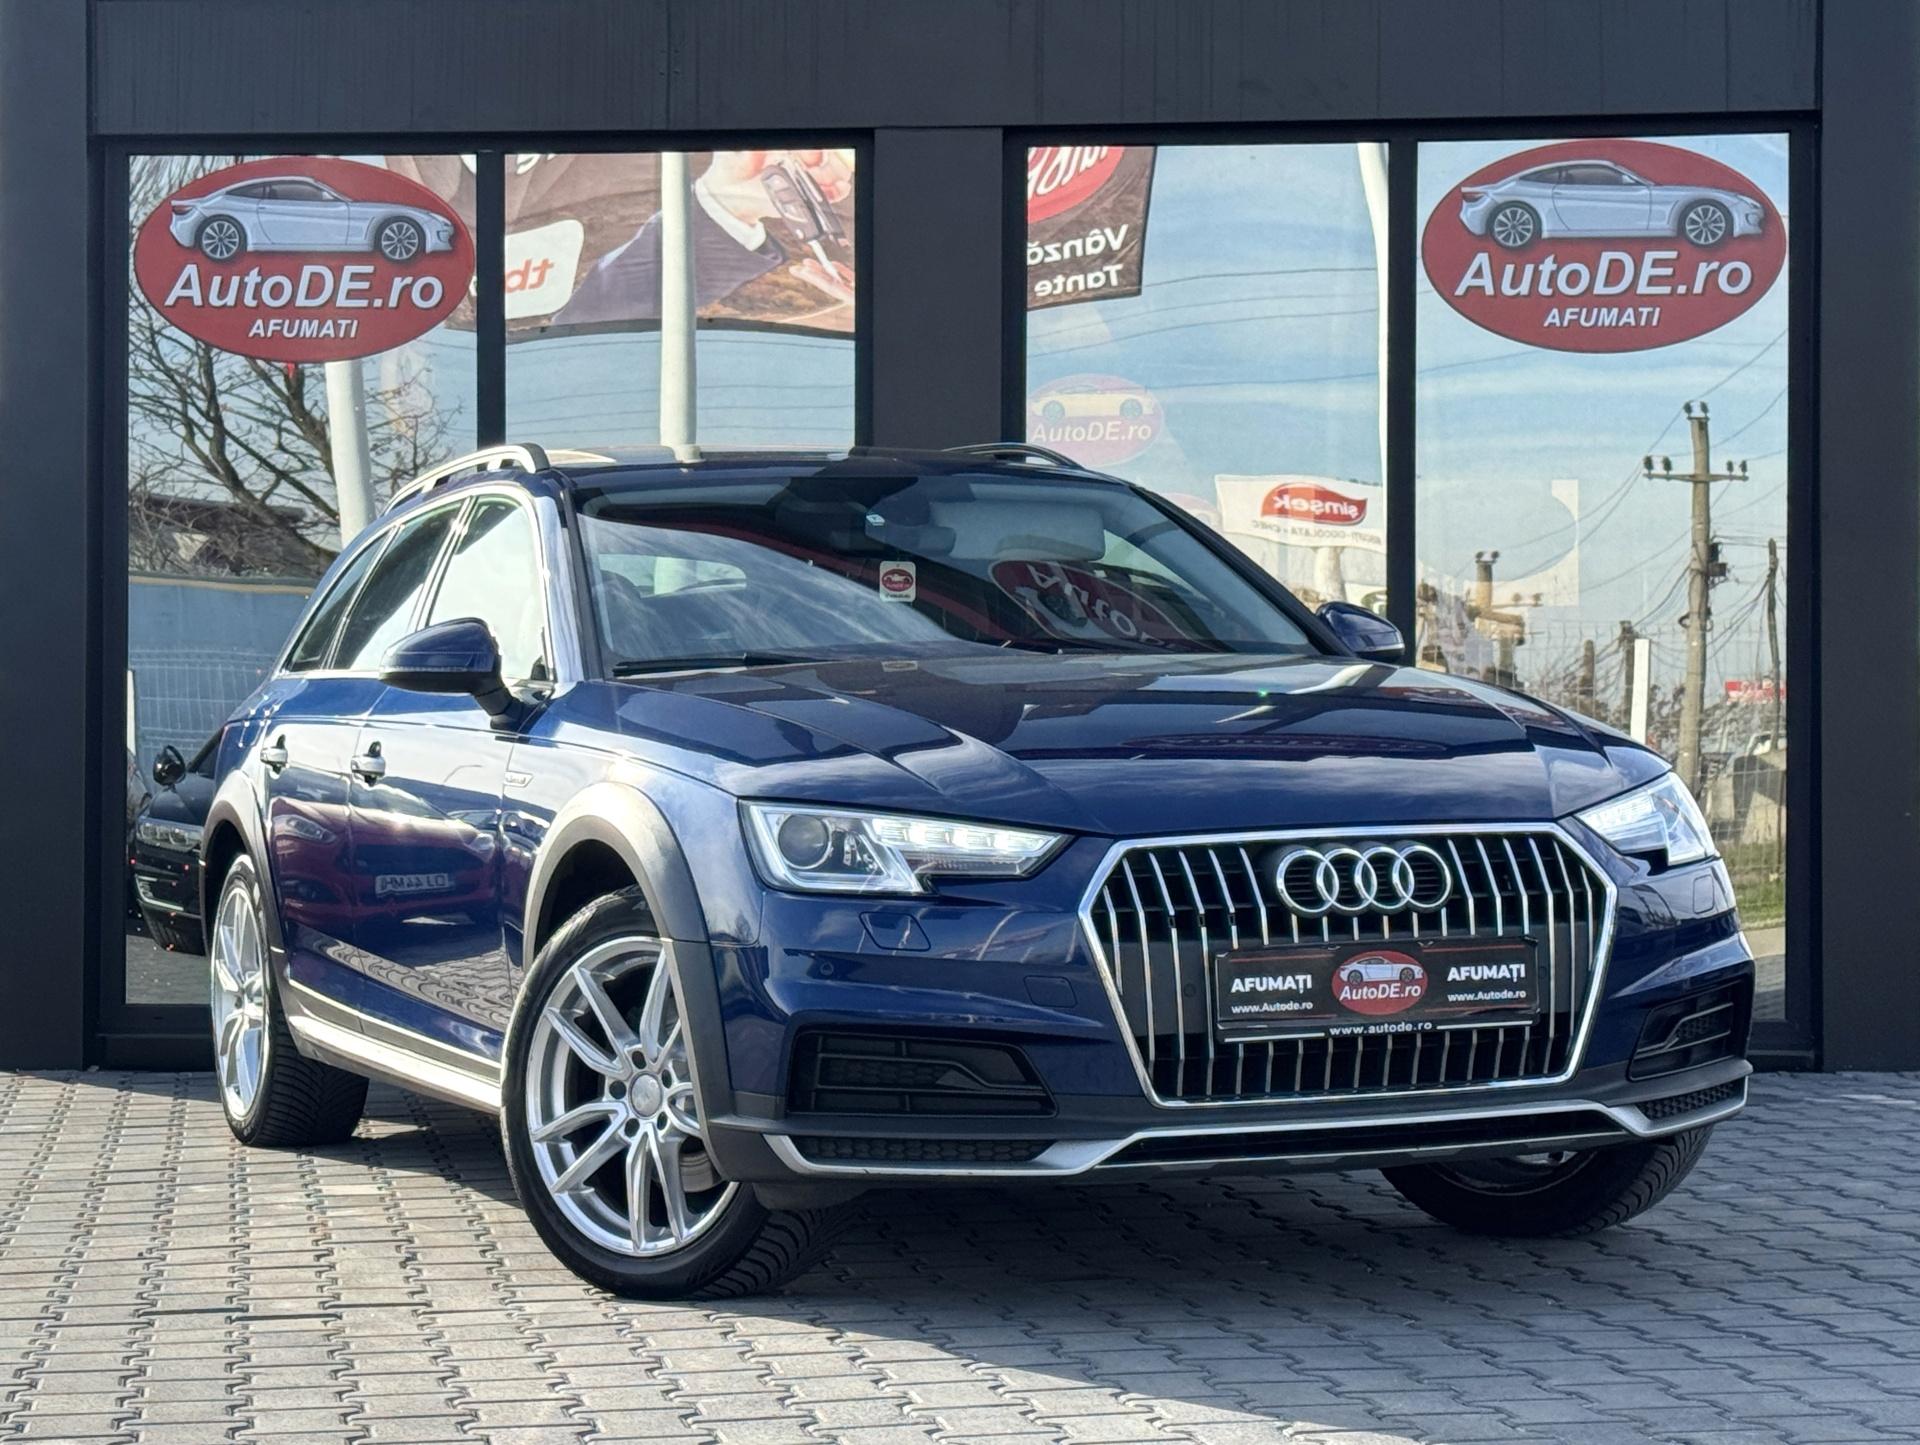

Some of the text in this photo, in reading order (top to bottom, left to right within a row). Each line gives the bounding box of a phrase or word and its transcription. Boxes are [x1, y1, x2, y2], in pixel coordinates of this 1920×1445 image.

[1454, 251, 1752, 296] AutoDE.ro
[165, 264, 443, 308] AutoDE.ro
[1544, 307, 1661, 327] AFUMATI
[248, 319, 358, 339] AFUMATI
[1031, 421, 1152, 443] AutoDE.ro
[1447, 964, 1526, 982] AFUMAȚI
[1231, 975, 1313, 994] AFUMAȚI
[1339, 983, 1421, 1000] AutoDE.ro
[1447, 989, 1526, 1002] www.Autode.ro
[1231, 1001, 1314, 1014] www.Autode.ro
[1329, 1021, 1432, 1035] www.autode.ro
